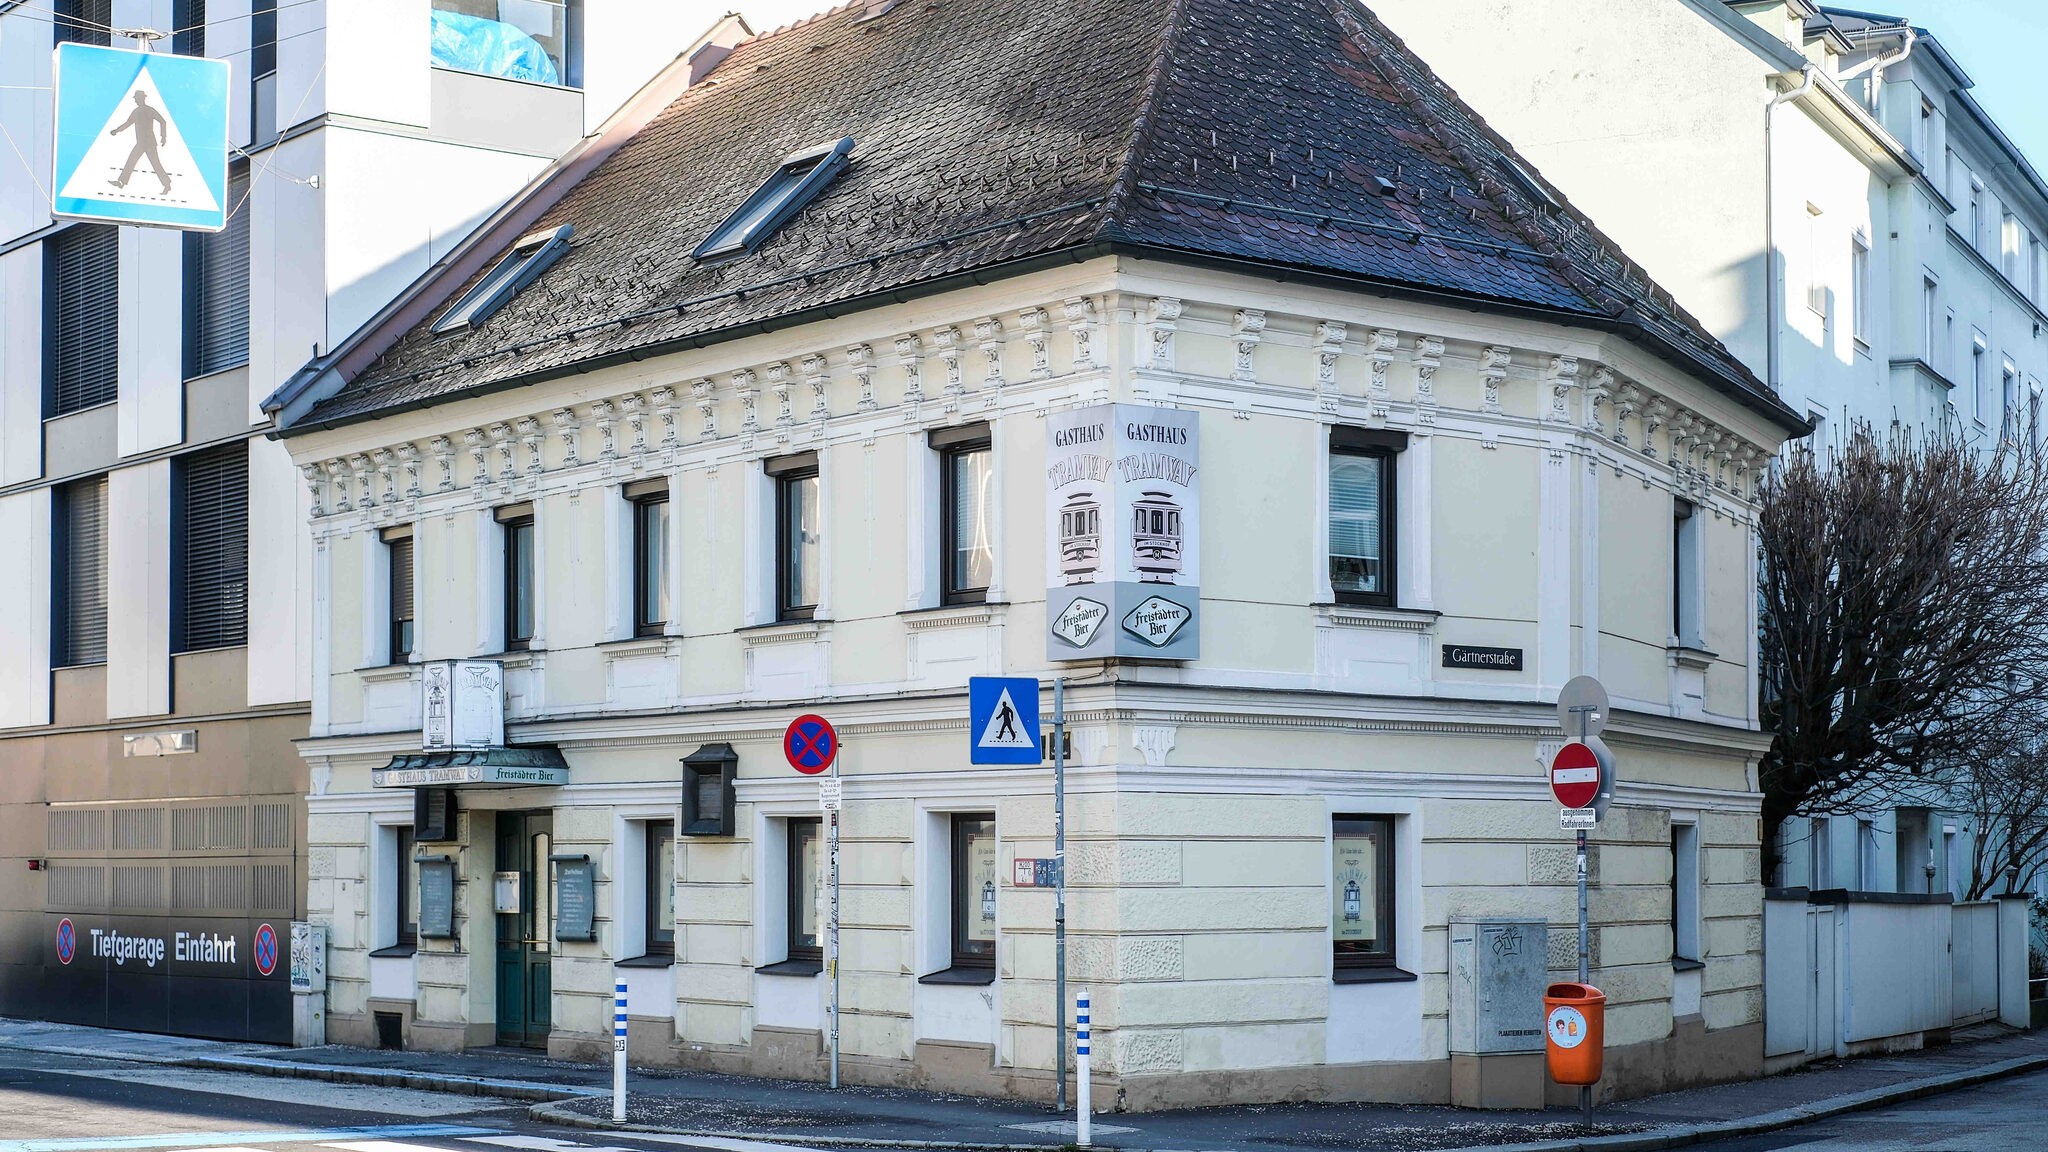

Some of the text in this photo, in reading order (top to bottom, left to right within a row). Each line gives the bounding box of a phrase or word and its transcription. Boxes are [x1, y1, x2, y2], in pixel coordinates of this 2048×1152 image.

[1055, 423, 1104, 447] GASTHAUS
[1127, 423, 1187, 445] GASTHAUS
[1048, 453, 1112, 490] TRAMWAY
[1117, 452, 1197, 488] TRAMWAY
[1074, 623, 1089, 637] Bier
[1149, 622, 1167, 636] Bier
[1452, 648, 1516, 665] Gärtnerstraße
[427, 768, 466, 782] TRAMWAY
[538, 769, 554, 781] Bier
[1562, 809, 1594, 817] ausgenommen
[90, 928, 236, 967] Tiefgarage Einfahrt
